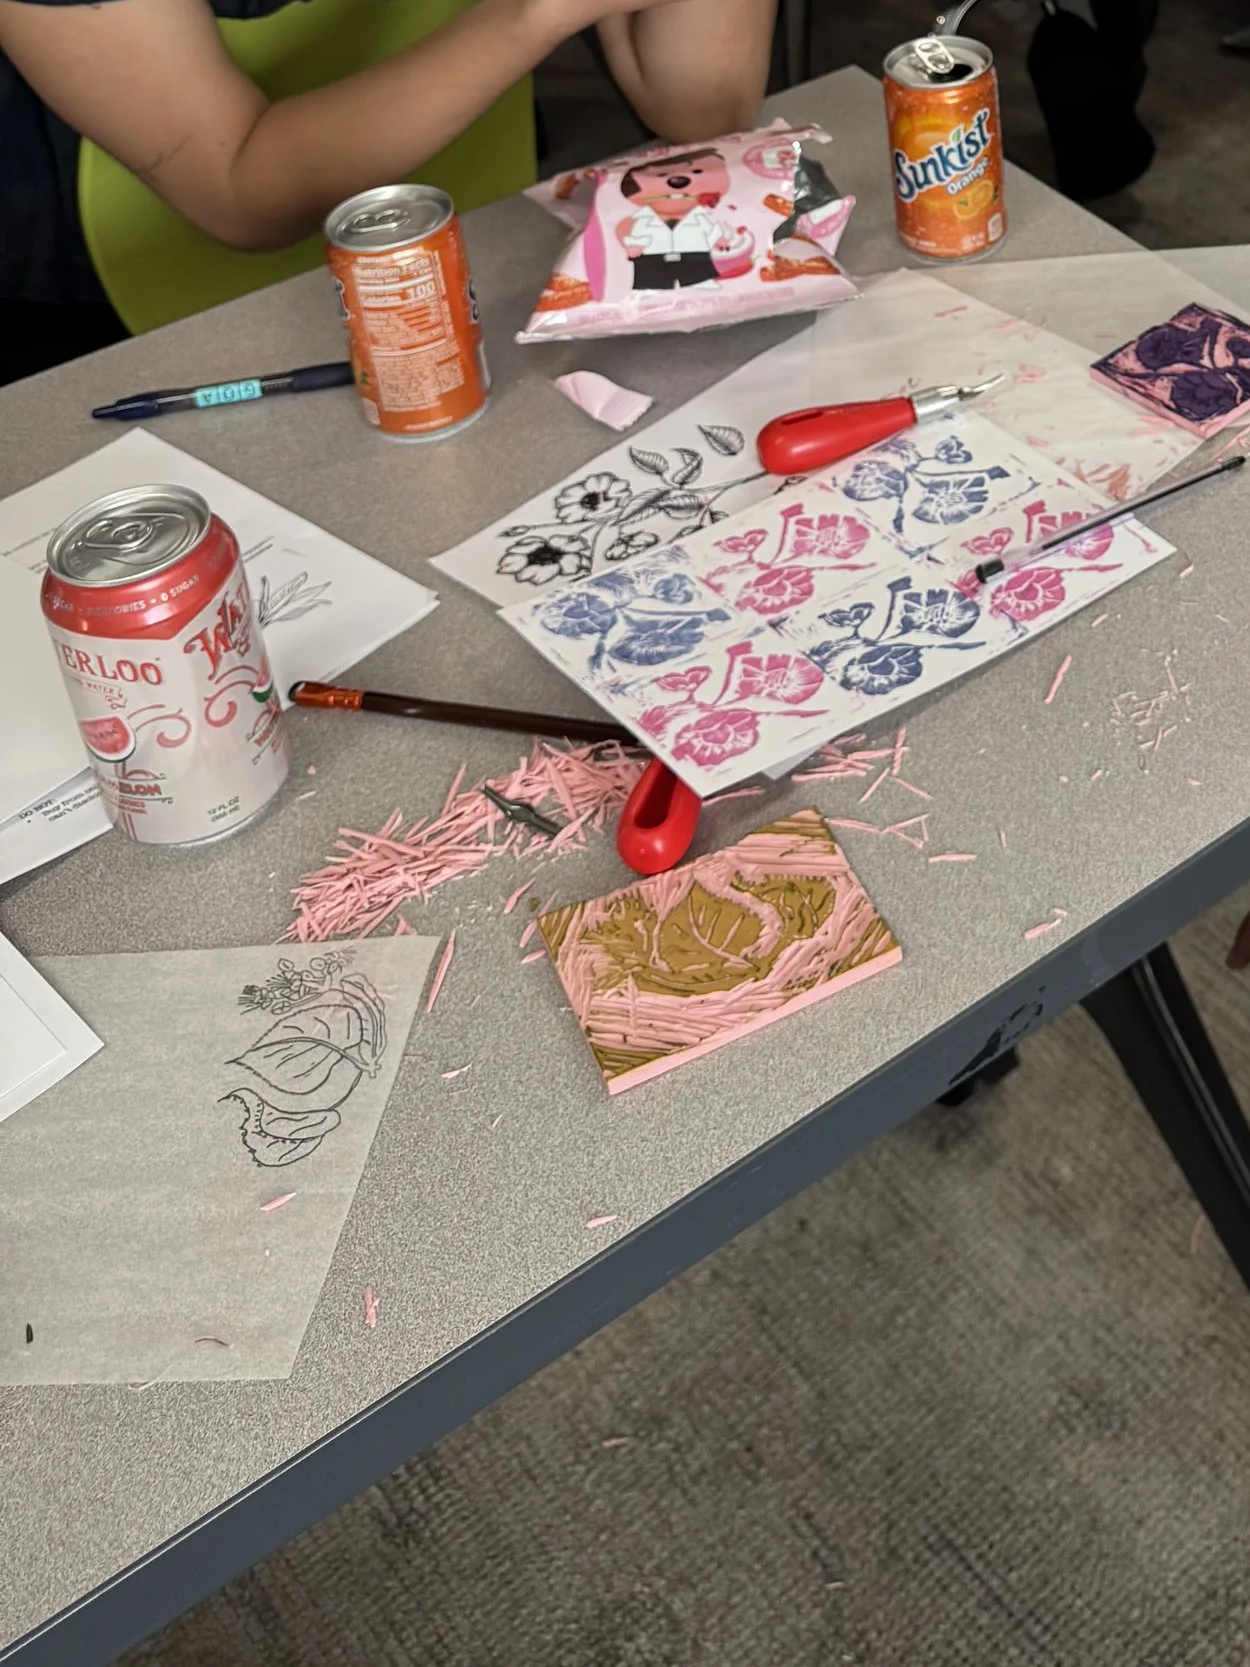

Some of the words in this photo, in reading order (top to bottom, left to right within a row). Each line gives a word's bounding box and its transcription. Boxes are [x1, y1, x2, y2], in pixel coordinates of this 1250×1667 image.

[893, 108, 990, 202] Sunkist
[948, 158, 988, 195] Orange
[406, 280, 436, 301] 100
